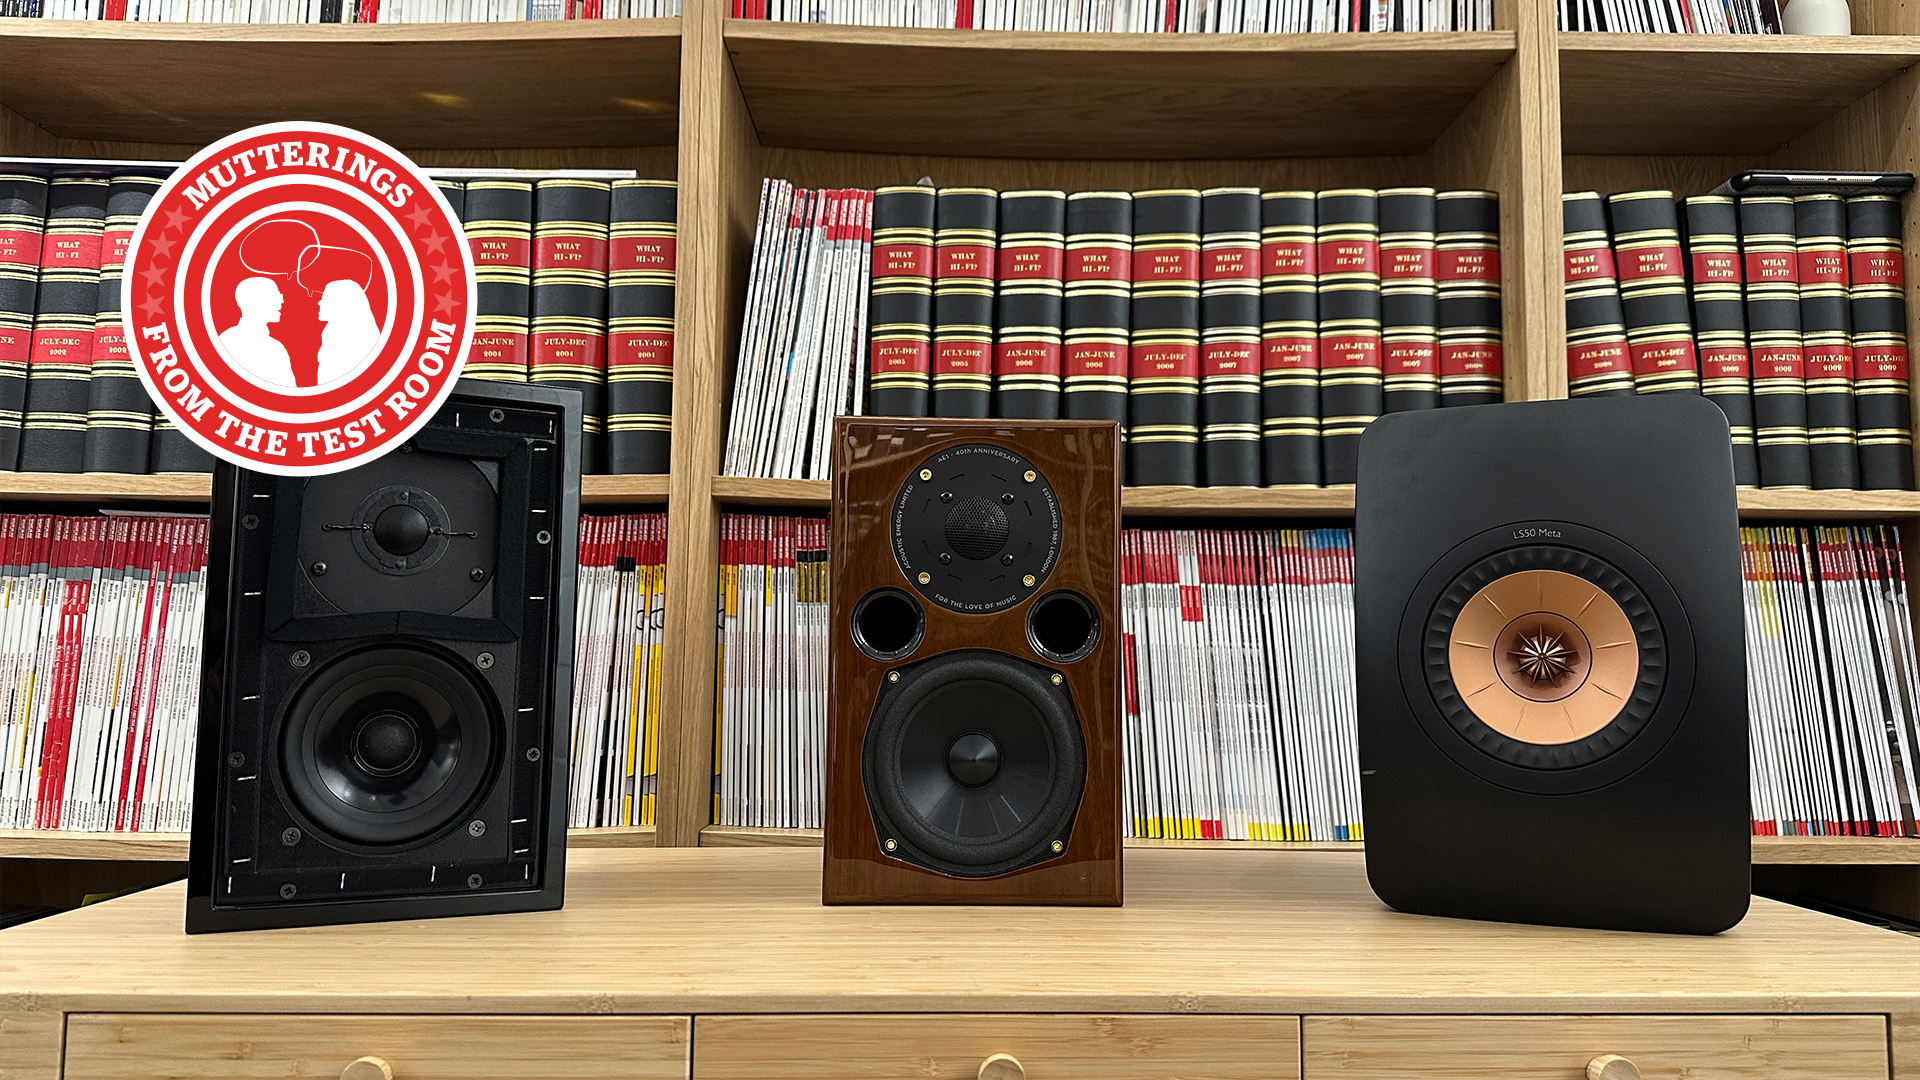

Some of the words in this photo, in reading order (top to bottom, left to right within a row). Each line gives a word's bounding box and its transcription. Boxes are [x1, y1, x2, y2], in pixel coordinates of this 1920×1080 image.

[637, 245, 661, 253] WHAT
[1338, 247, 1363, 255] WHAT
[1015, 254, 1040, 262] WHAT
[1396, 254, 1422, 262] WHAT
[1458, 255, 1483, 263] WHAT
[1570, 254, 1596, 264] WHAT
[1638, 253, 1665, 262] WHAT
[1815, 258, 1841, 266] WHAT
[1707, 259, 1732, 268] WHAT
[1762, 258, 1788, 267] WHAT
[1870, 259, 1895, 267] WHAT
[955, 448, 972, 456] 40th
[973, 447, 1020, 465] ANNIVERSARY
[899, 484, 914, 510] LIMITED
[1042, 487, 1058, 529] ESTABLISHED
[896, 509, 904, 537] ENERGY
[1512, 528, 1536, 539] LS50
[1538, 528, 1562, 538] Meta
[896, 537, 912, 570] ACOUSTIC
[1041, 546, 1056, 573] LONDON
[935, 593, 949, 604] FOR
[950, 600, 963, 609] THE
[996, 594, 1017, 607] MUSIC
